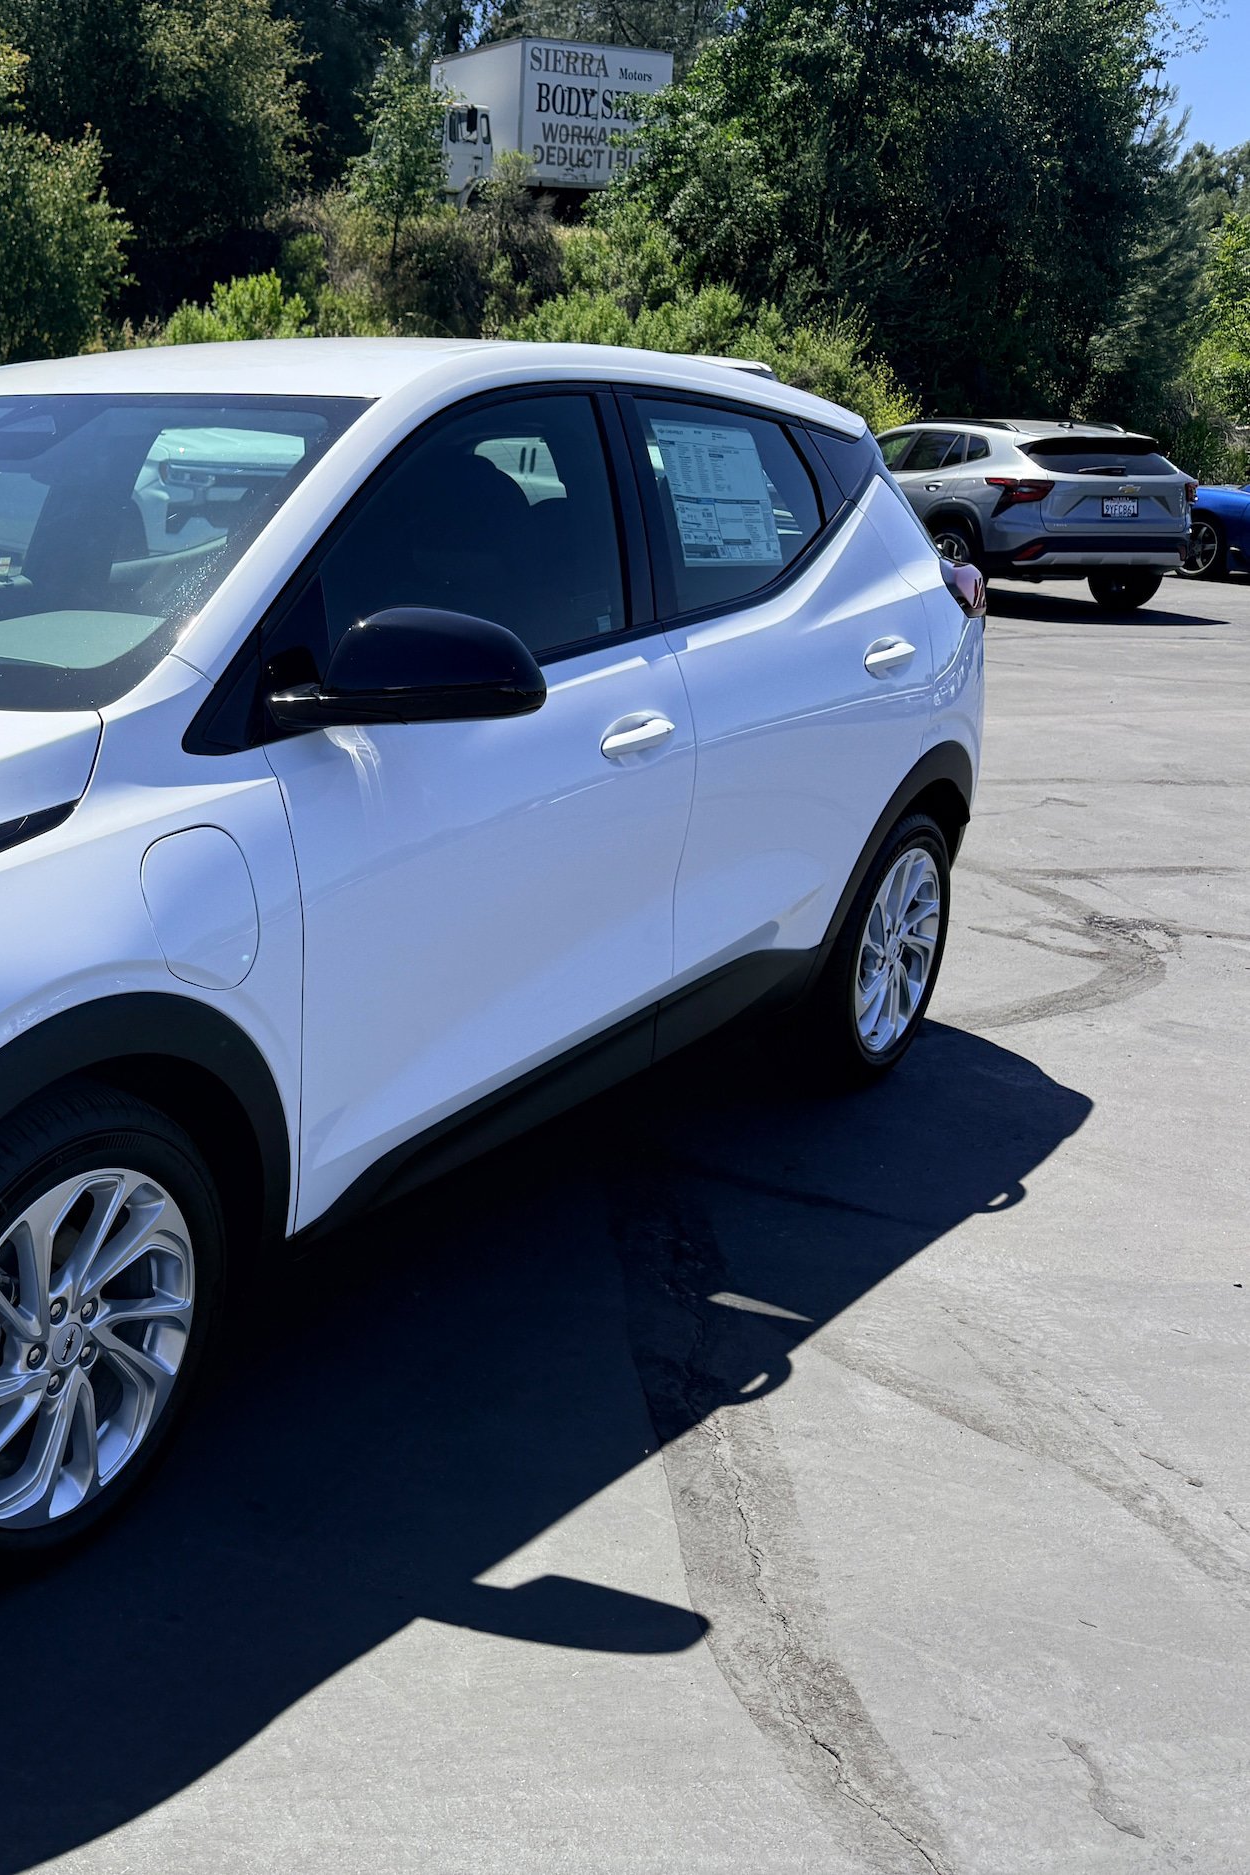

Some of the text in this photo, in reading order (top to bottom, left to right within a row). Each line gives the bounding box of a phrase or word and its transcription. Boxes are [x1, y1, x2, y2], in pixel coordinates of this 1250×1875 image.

[530, 46, 653, 82] SIERRA Motors
[536, 82, 598, 118] BODY
[542, 122, 642, 148] WORKA
[533, 144, 645, 170] DEDUCTIBL
